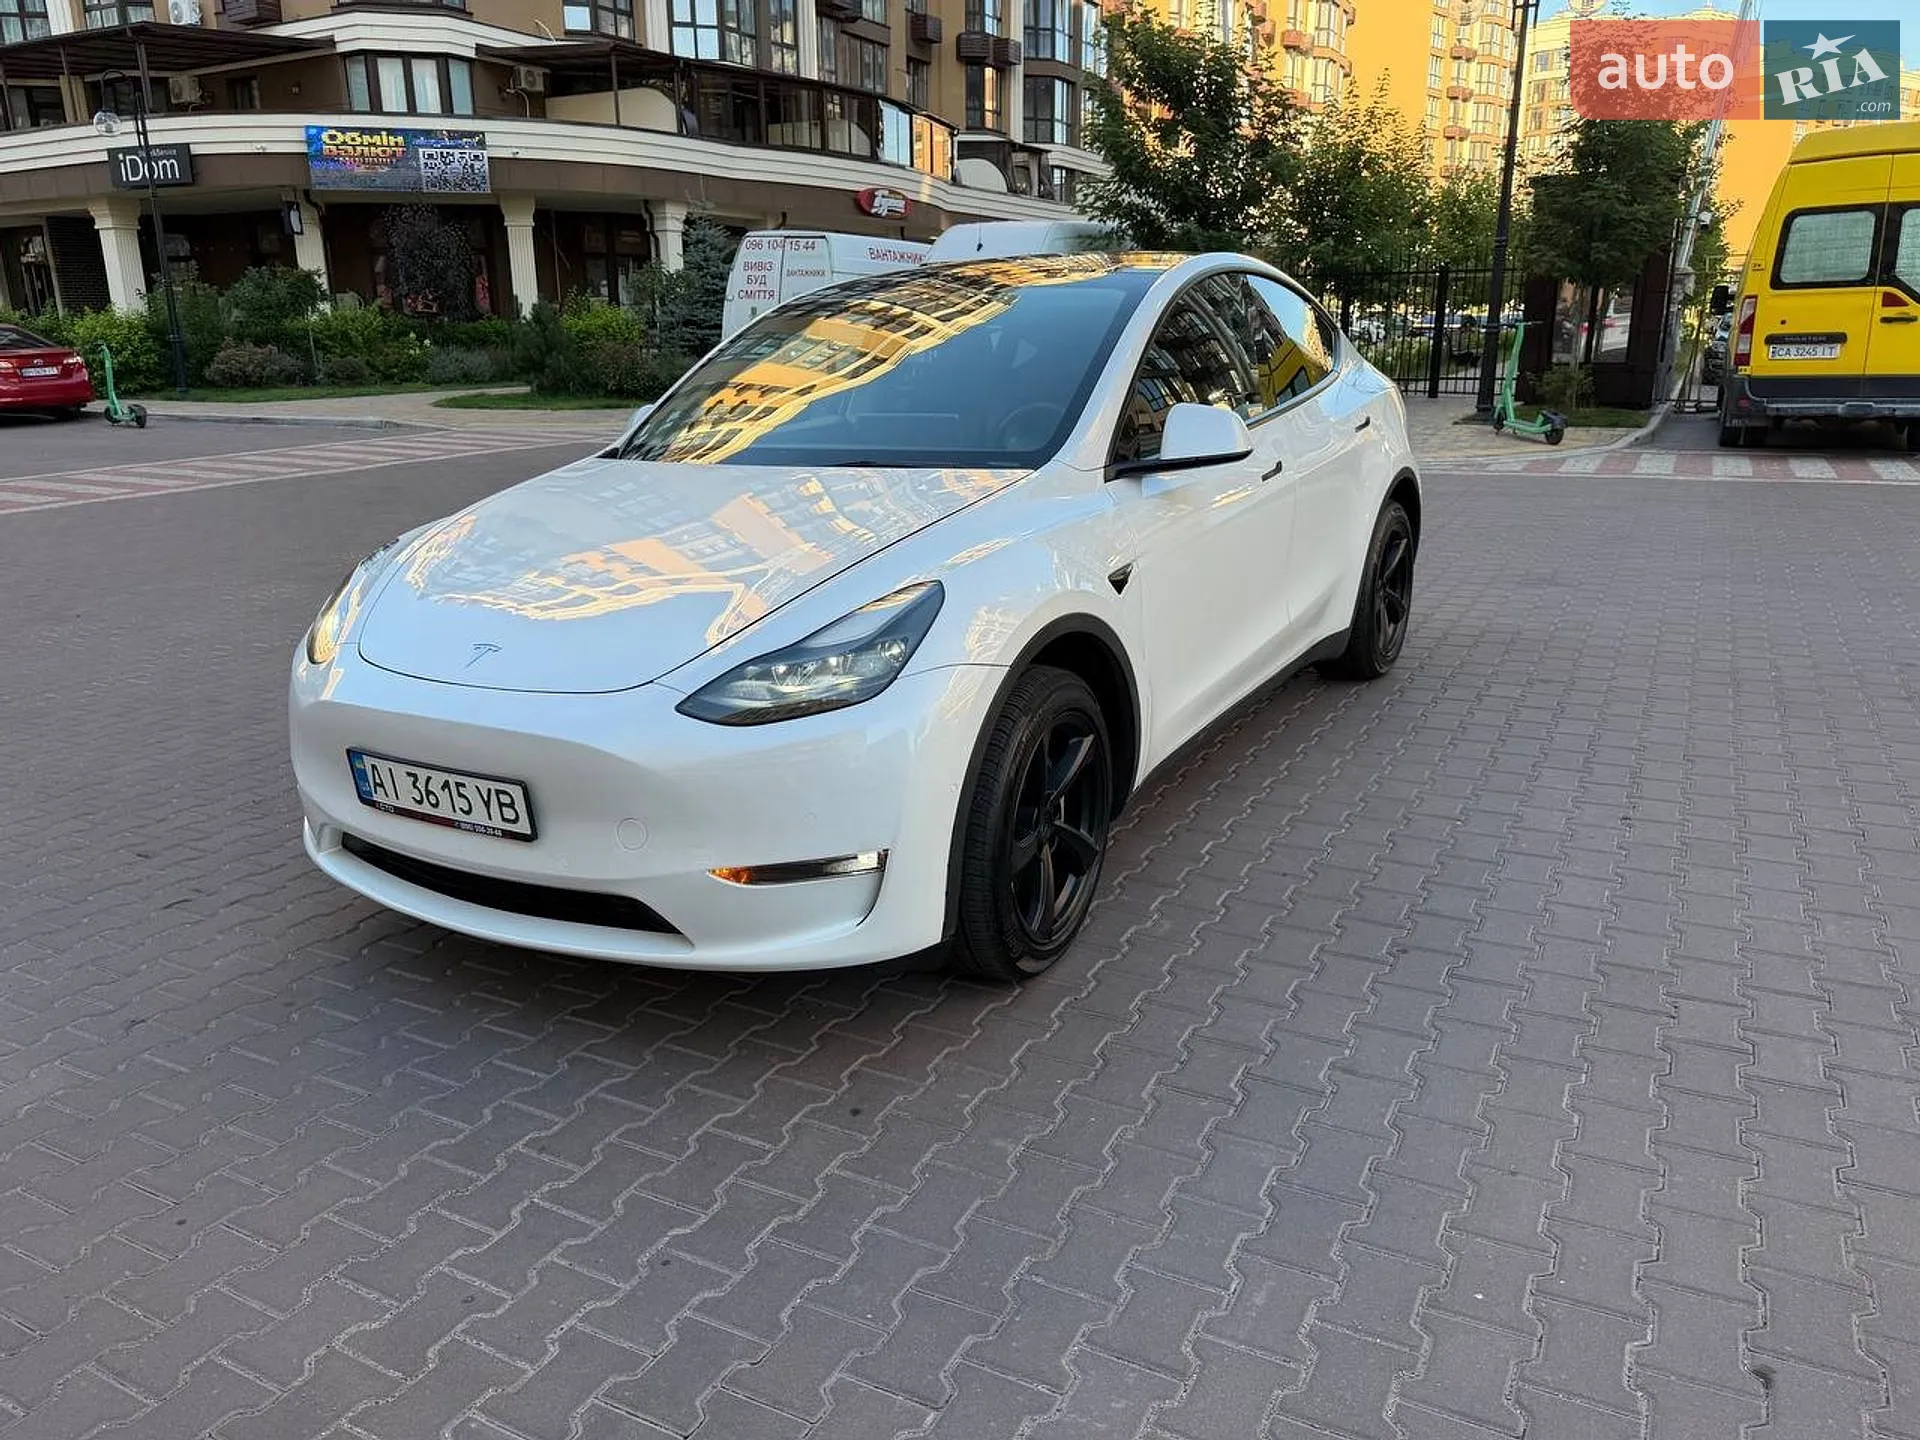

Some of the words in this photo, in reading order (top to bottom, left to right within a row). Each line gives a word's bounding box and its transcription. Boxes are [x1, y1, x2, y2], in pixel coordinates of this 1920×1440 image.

[117, 153, 180, 182] iDom
[745, 239, 764, 250] 096
[789, 240, 801, 252] 15
[743, 260, 774, 272] ВИВІЗ
[746, 274, 767, 286] БУД
[738, 289, 776, 301] СМІТТЯ
[370, 763, 399, 801] AI
[406, 771, 473, 816] 3615
[475, 784, 520, 825] YB
